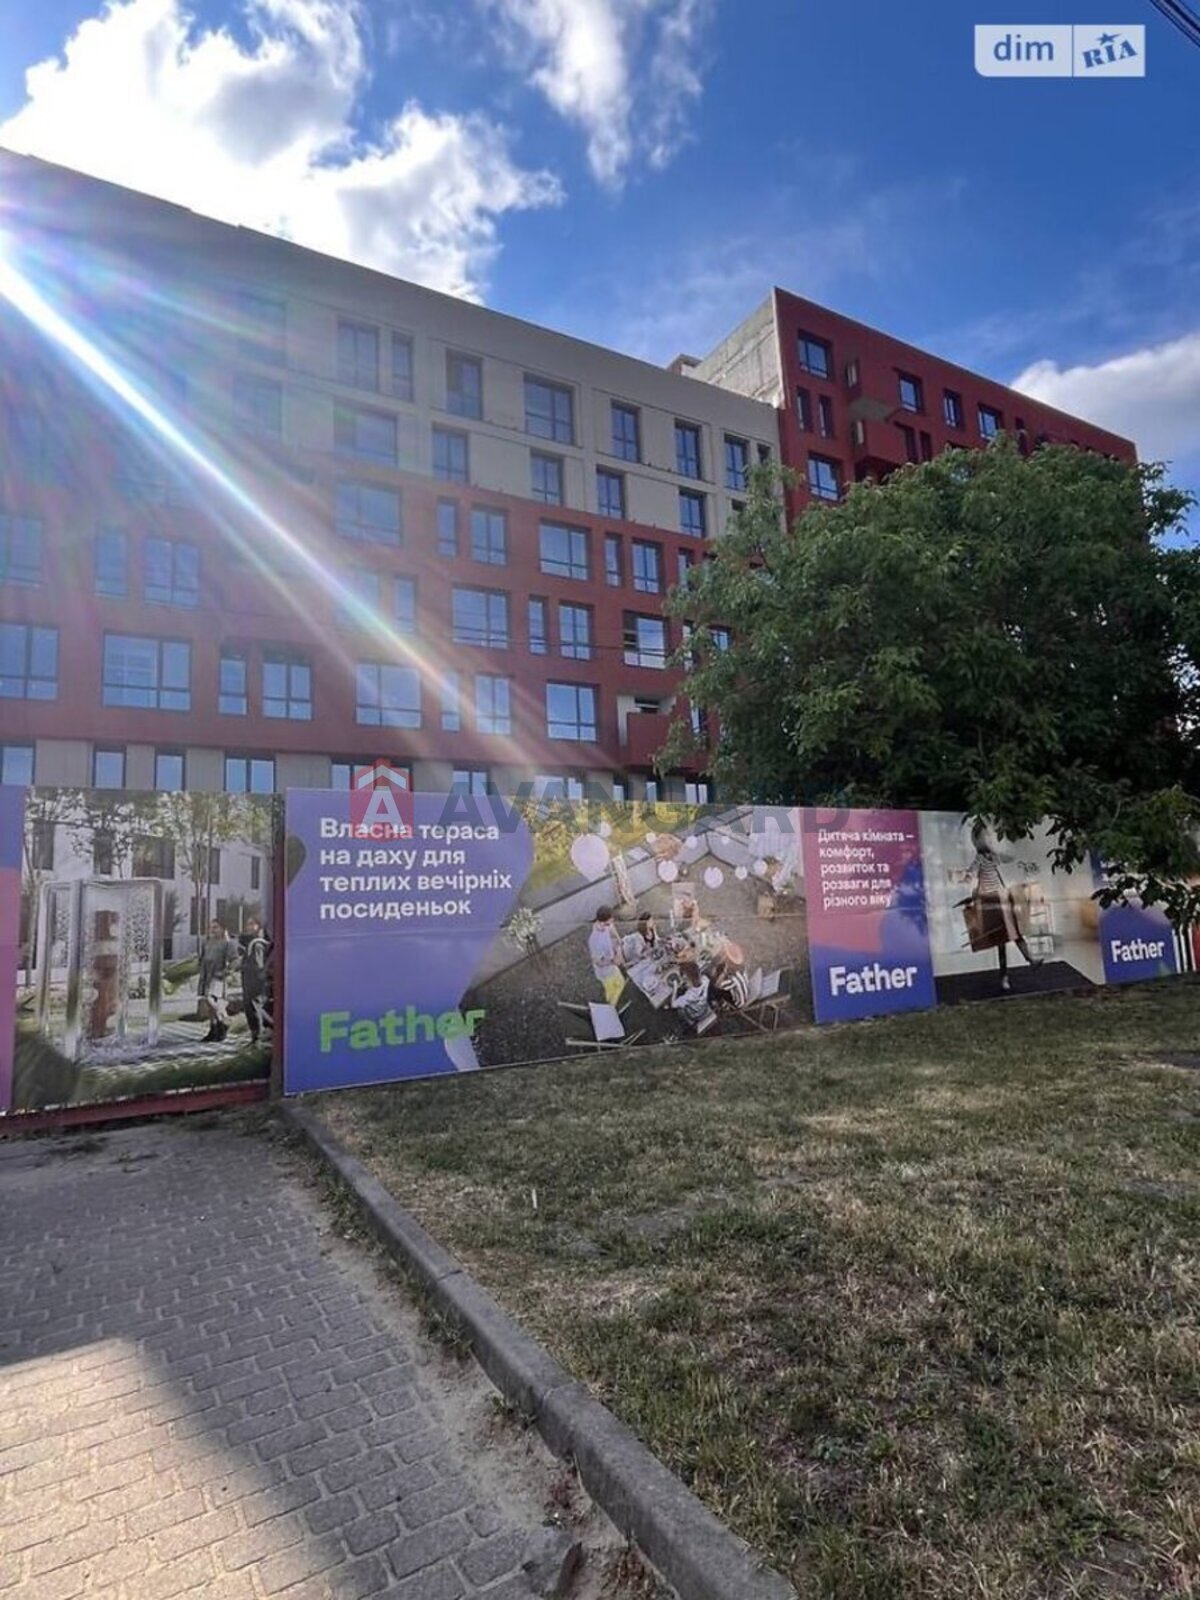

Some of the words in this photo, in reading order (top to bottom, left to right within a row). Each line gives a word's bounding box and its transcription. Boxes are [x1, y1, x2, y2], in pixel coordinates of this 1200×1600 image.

[320, 817, 414, 840] Власна
[419, 824, 500, 845] тераса
[818, 828, 860, 843] Дитяча
[862, 828, 905, 842] кімната
[320, 850, 350, 866] на
[356, 850, 417, 871] даху
[422, 850, 466, 867] для
[819, 845, 875, 861] комфорт,
[820, 863, 875, 877] розвиток
[876, 863, 890, 873] та
[320, 876, 412, 892] теплих
[417, 869, 512, 894] вечірніх
[822, 880, 869, 893] розваги
[320, 900, 472, 920] посиденьок
[823, 893, 868, 910] різного
[1110, 939, 1165, 963] Father
[829, 962, 918, 996] Father
[319, 1004, 486, 1053] Father
